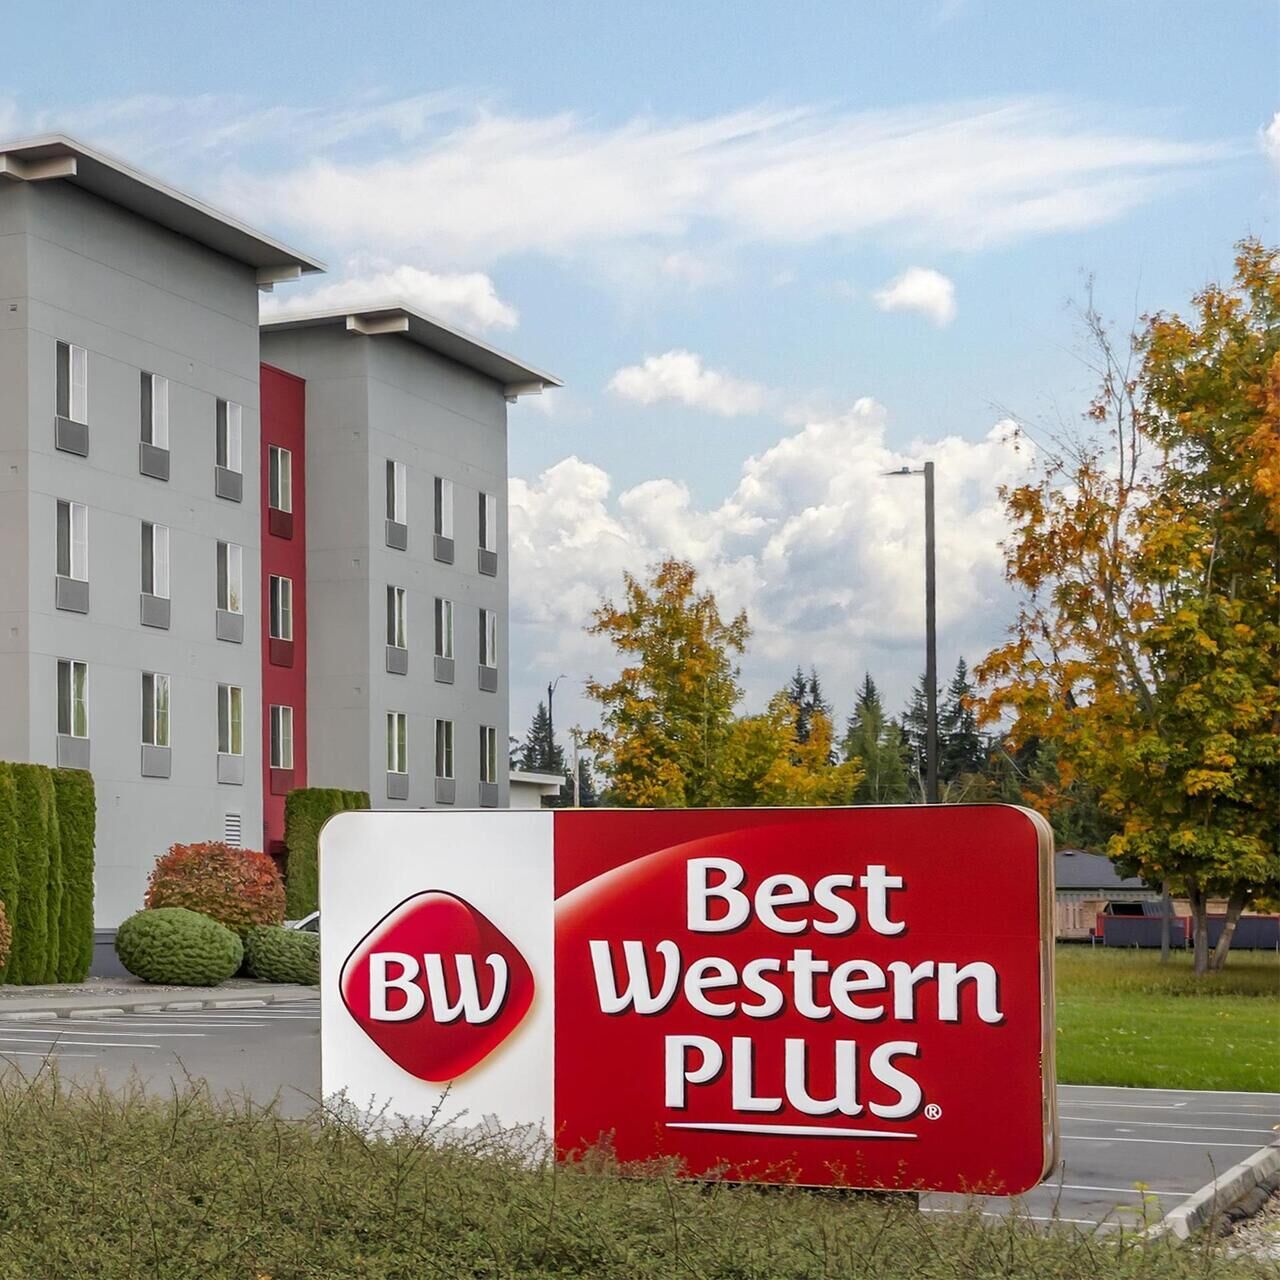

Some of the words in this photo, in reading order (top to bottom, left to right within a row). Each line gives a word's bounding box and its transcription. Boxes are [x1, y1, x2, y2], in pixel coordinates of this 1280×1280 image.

[686, 856, 907, 936] Best
[368, 951, 508, 1025] BW
[588, 939, 1005, 1024] Western
